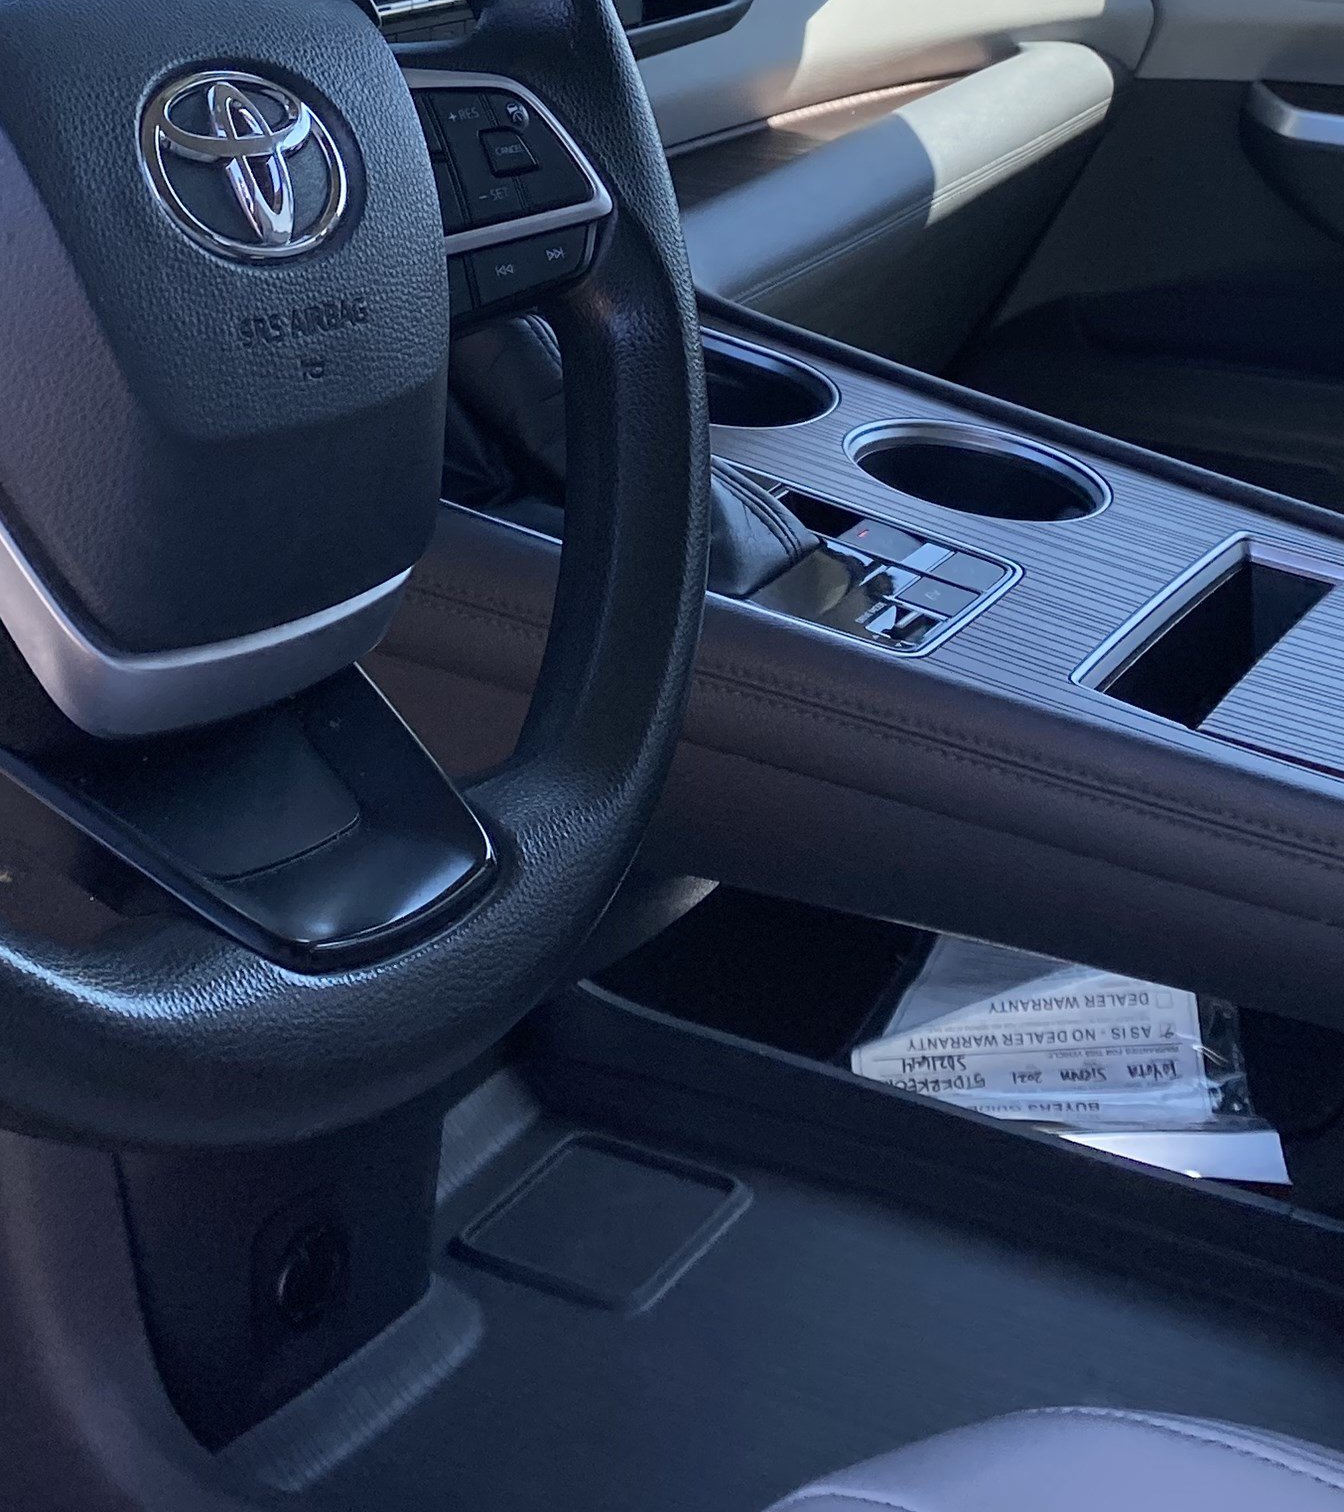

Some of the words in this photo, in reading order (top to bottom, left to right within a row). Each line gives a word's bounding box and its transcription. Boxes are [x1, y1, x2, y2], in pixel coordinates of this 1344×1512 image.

[239, 314, 284, 347] SRS
[290, 296, 369, 339] AIRBAG
[988, 995, 1080, 1014] WARRANTY
[1085, 991, 1150, 1009] DEALER
[907, 1034, 999, 1053] WARRANTY
[1002, 1029, 1068, 1047] DEALER
[1072, 1027, 1097, 1042] NO
